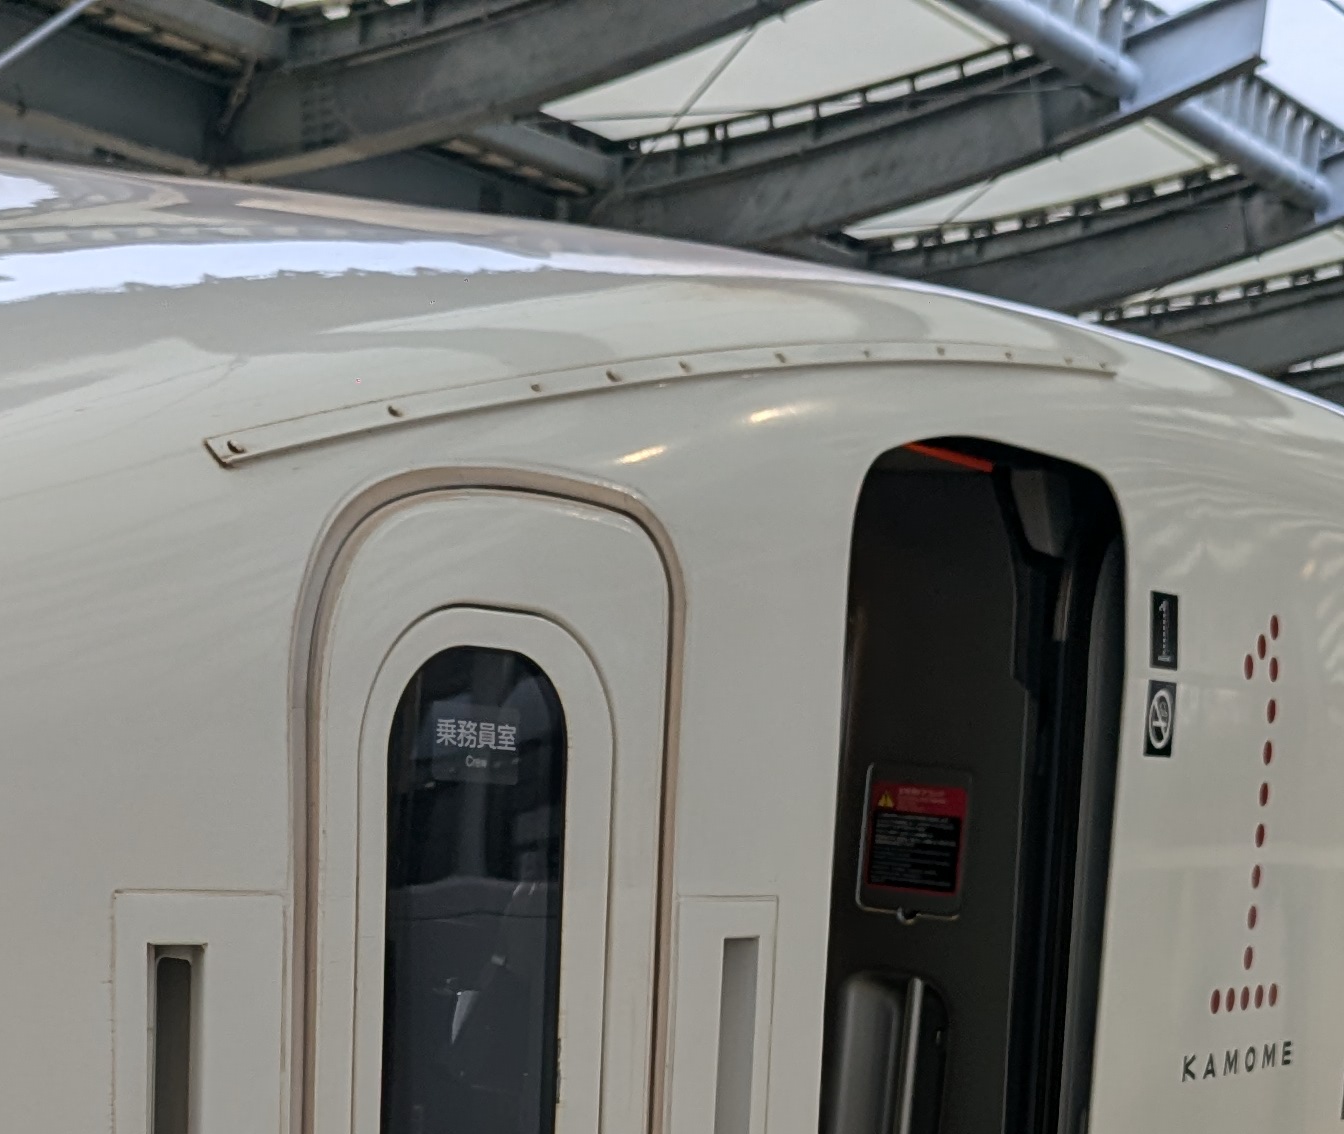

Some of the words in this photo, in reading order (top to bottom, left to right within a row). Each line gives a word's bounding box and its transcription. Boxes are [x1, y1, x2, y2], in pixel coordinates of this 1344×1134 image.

[435, 718, 517, 752] 乗務員室
[1181, 1040, 1294, 1083] KAMOME
